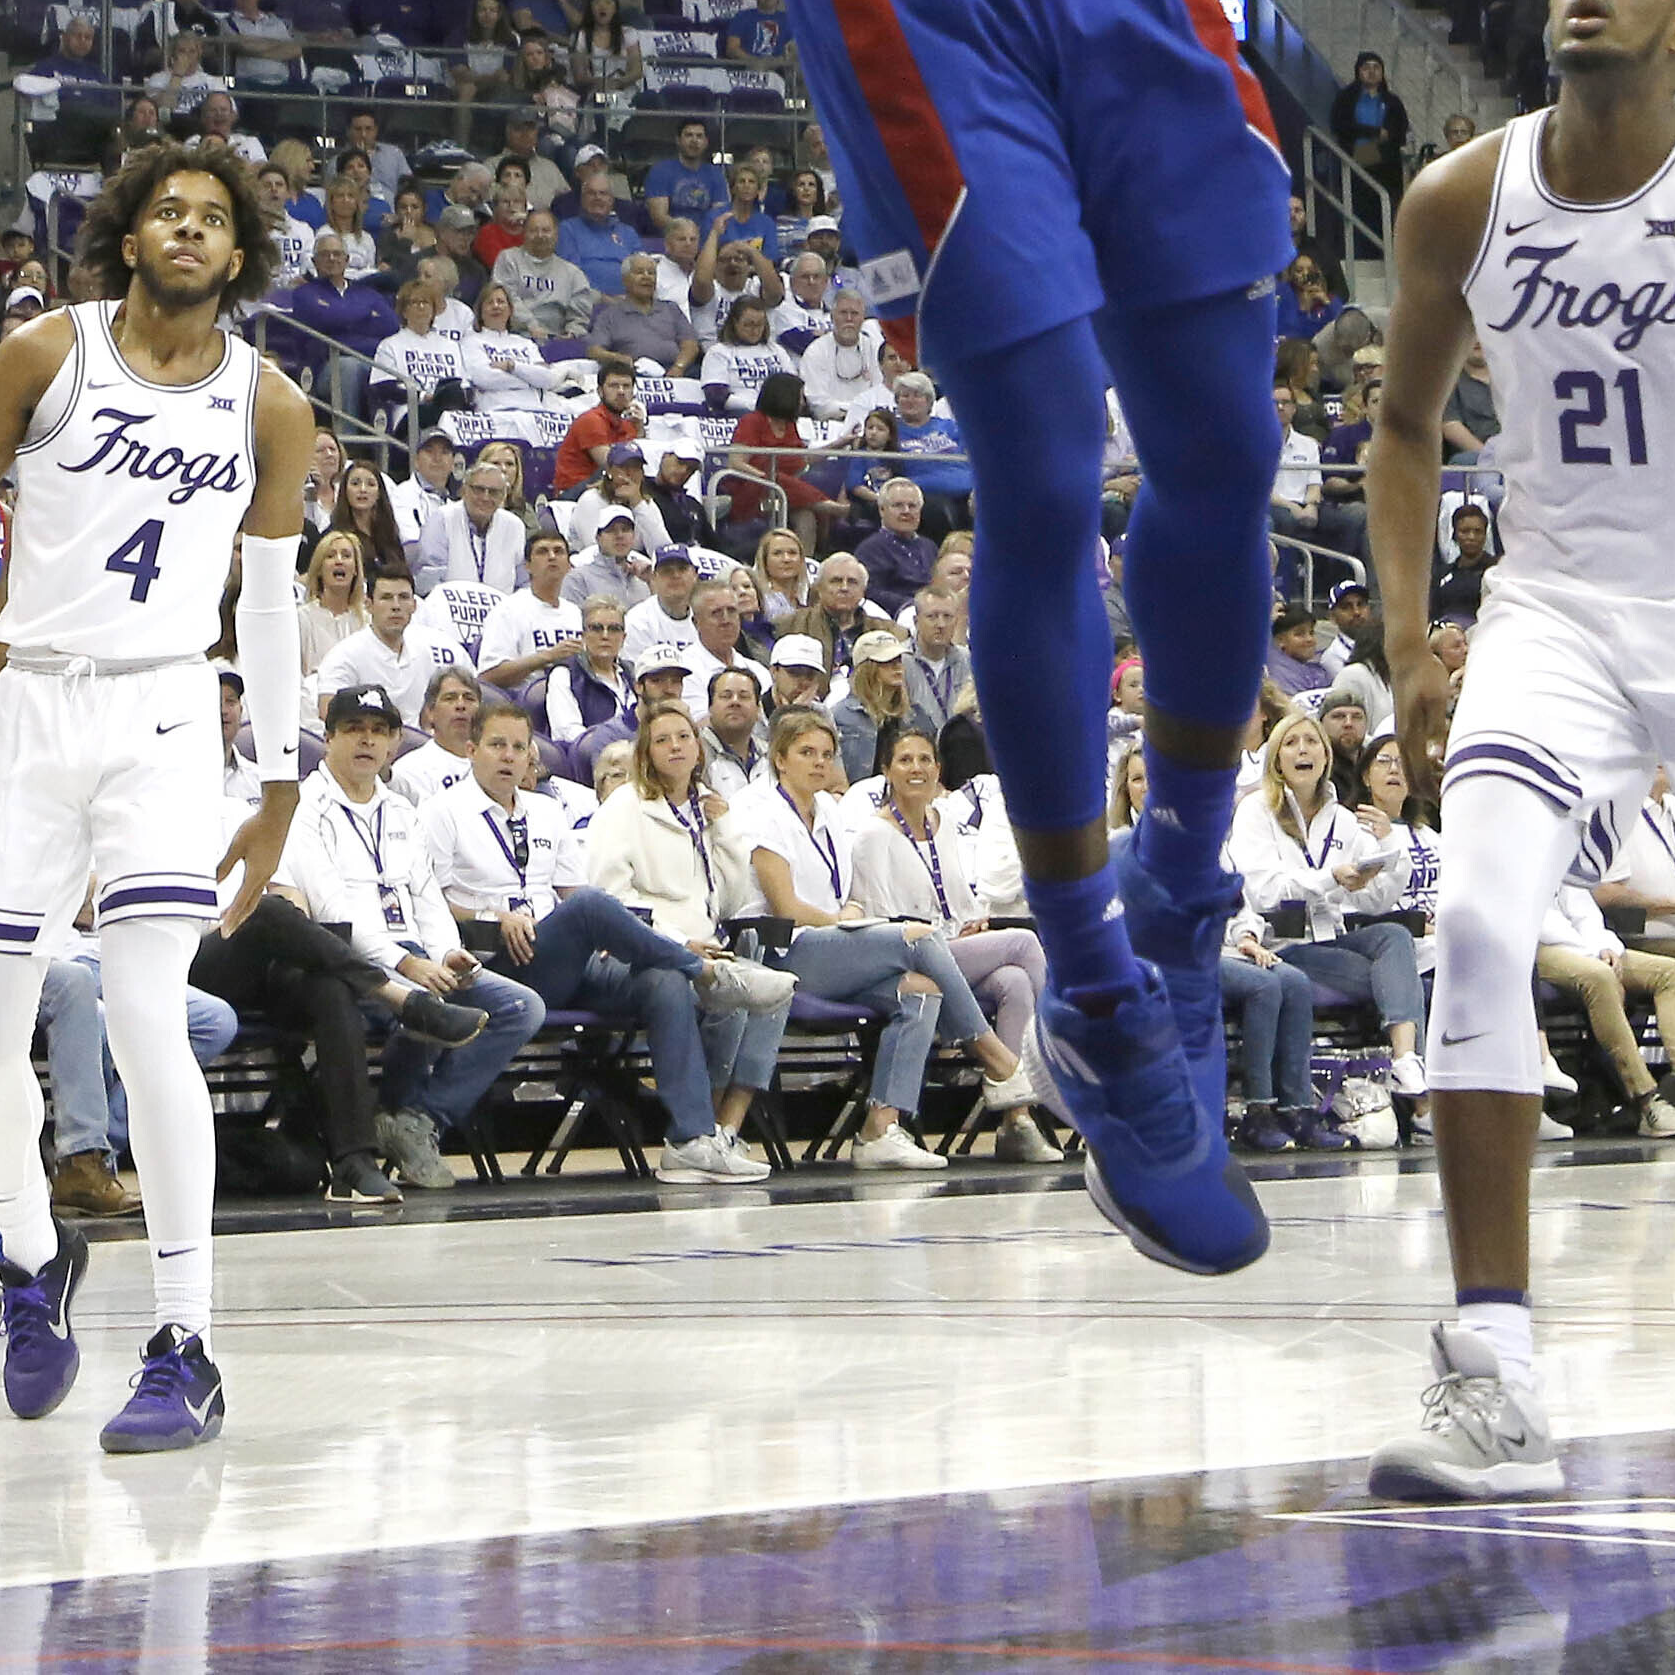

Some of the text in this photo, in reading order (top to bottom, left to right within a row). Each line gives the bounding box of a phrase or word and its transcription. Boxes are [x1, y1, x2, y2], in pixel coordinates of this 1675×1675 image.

[405, 350, 455, 366] BLEED
[637, 379, 676, 392] LEED
[1552, 368, 1649, 466] 21
[57, 407, 247, 504] Frogs
[104, 518, 165, 604] 4
[450, 604, 490, 624] PURP
